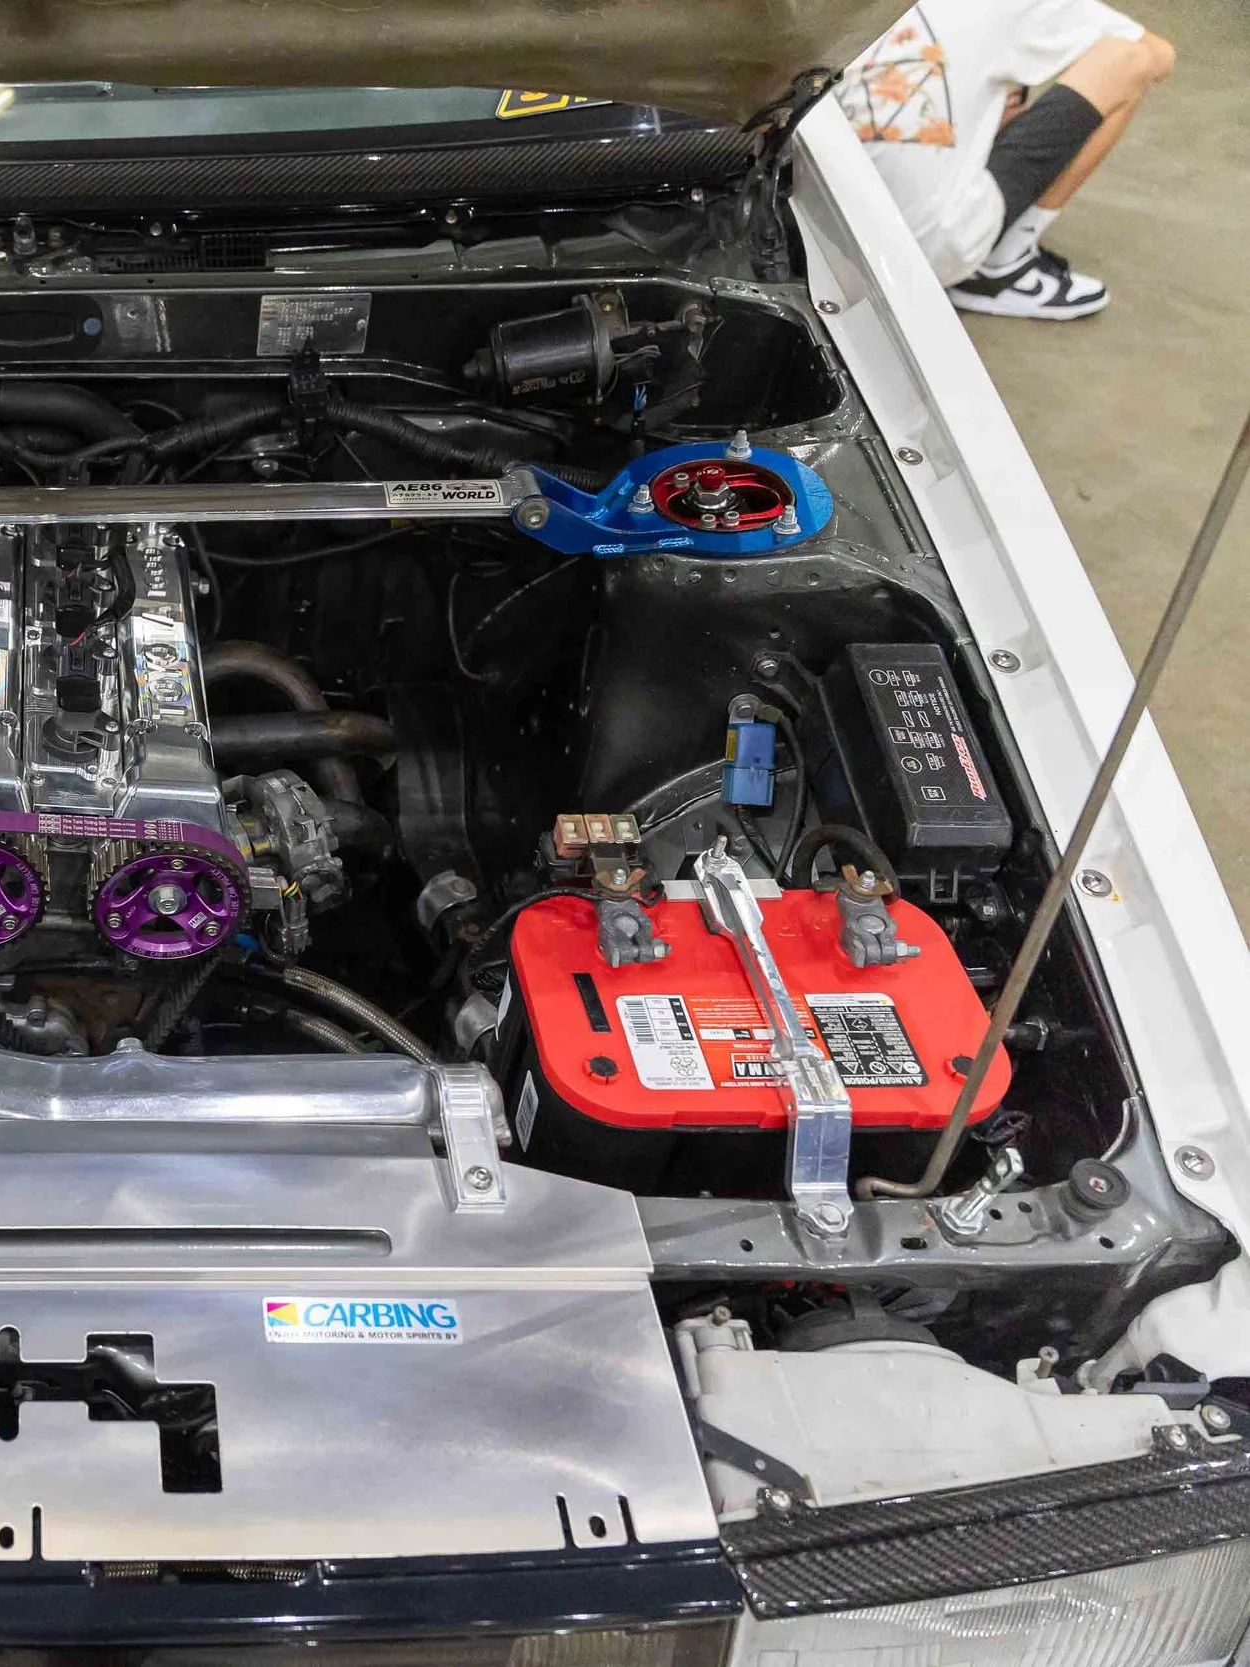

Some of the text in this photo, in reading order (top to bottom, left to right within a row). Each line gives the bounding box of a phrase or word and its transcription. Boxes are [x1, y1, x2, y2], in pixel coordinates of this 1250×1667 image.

[392, 483, 443, 492] AE86
[442, 491, 496, 500] WORLD
[140, 603, 188, 720] TOYOTA
[928, 692, 942, 716] NOTICE
[843, 1076, 914, 1085] DANGER/POISON
[303, 1303, 457, 1329] CARBING
[302, 1331, 355, 1339] MOTORING
[358, 1331, 365, 1339] &
[368, 1332, 402, 1340] MOTOR
[406, 1332, 443, 1340] SPIRITS
